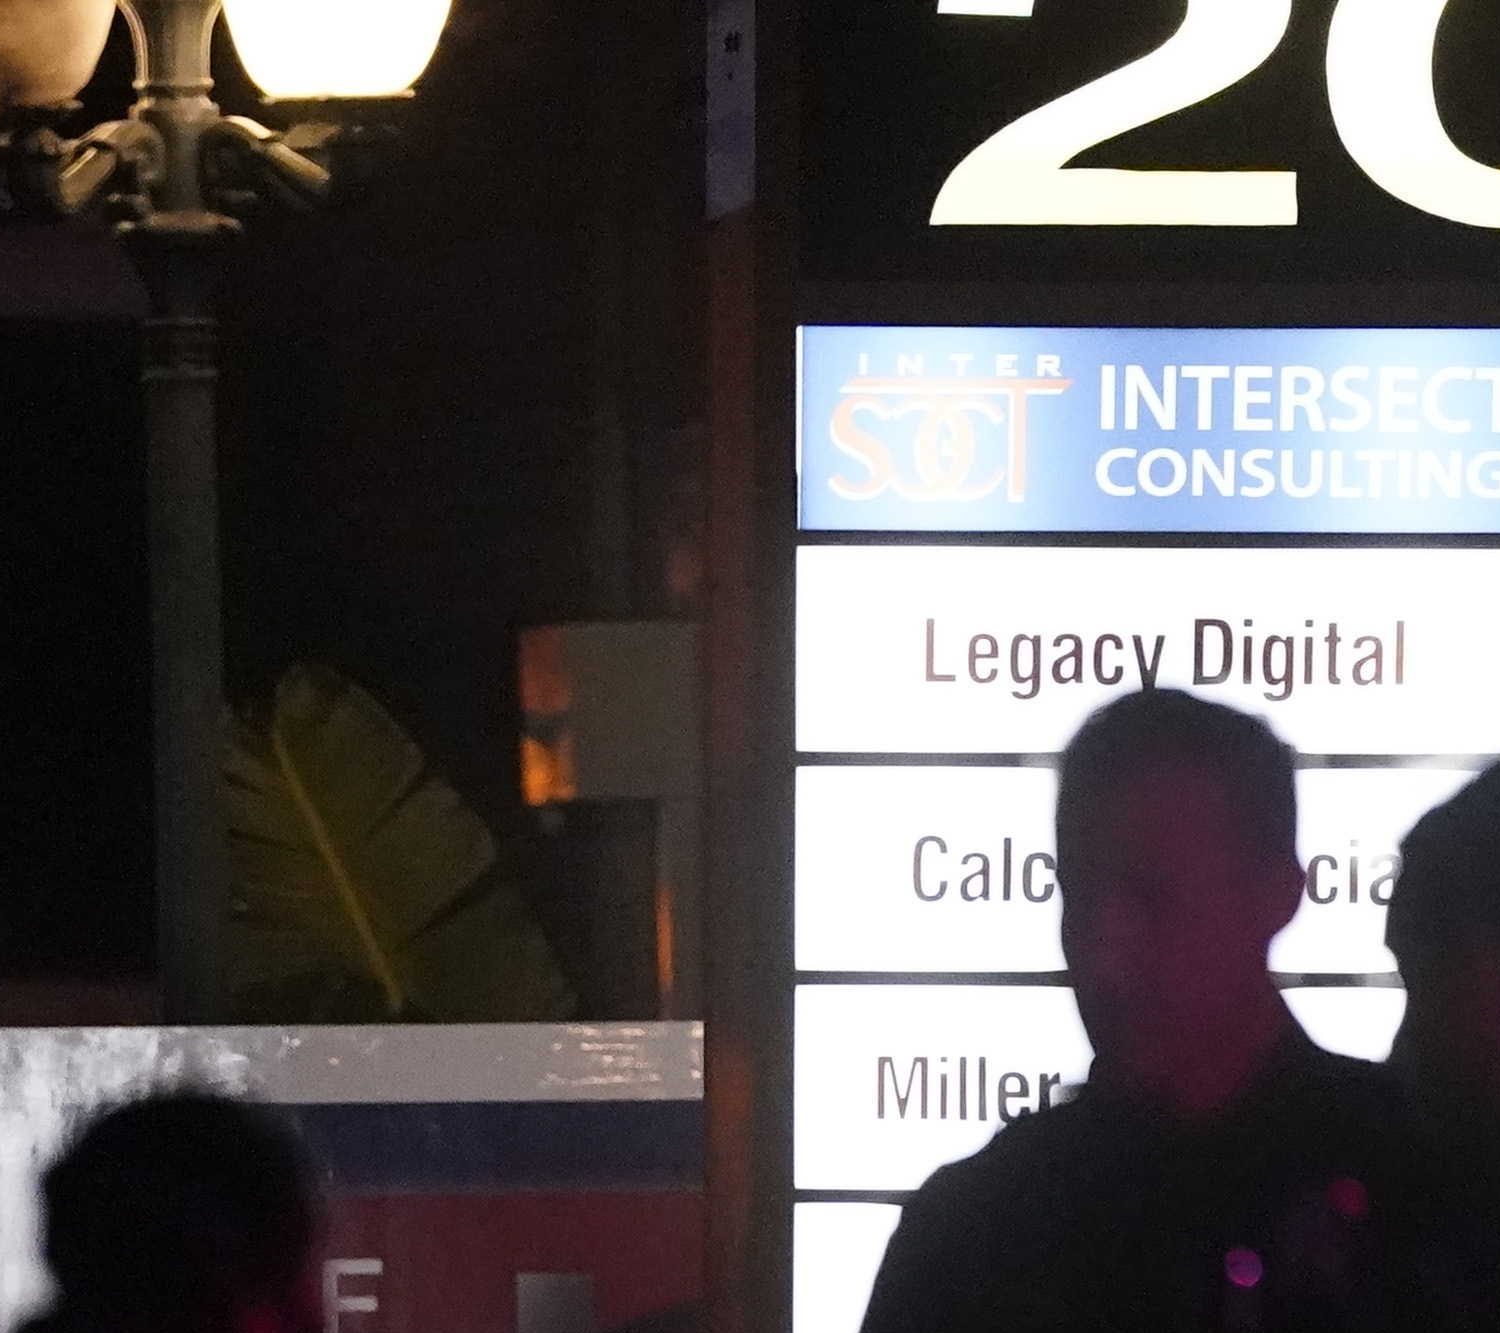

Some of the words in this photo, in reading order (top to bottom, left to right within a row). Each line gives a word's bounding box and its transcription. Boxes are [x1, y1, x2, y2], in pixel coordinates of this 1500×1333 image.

[858, 353, 1062, 377] INTER
[924, 619, 1166, 700] Legacy
[1192, 619, 1406, 701] Digital
[912, 835, 1057, 903] Calc
[876, 1056, 1061, 1123] Miller
